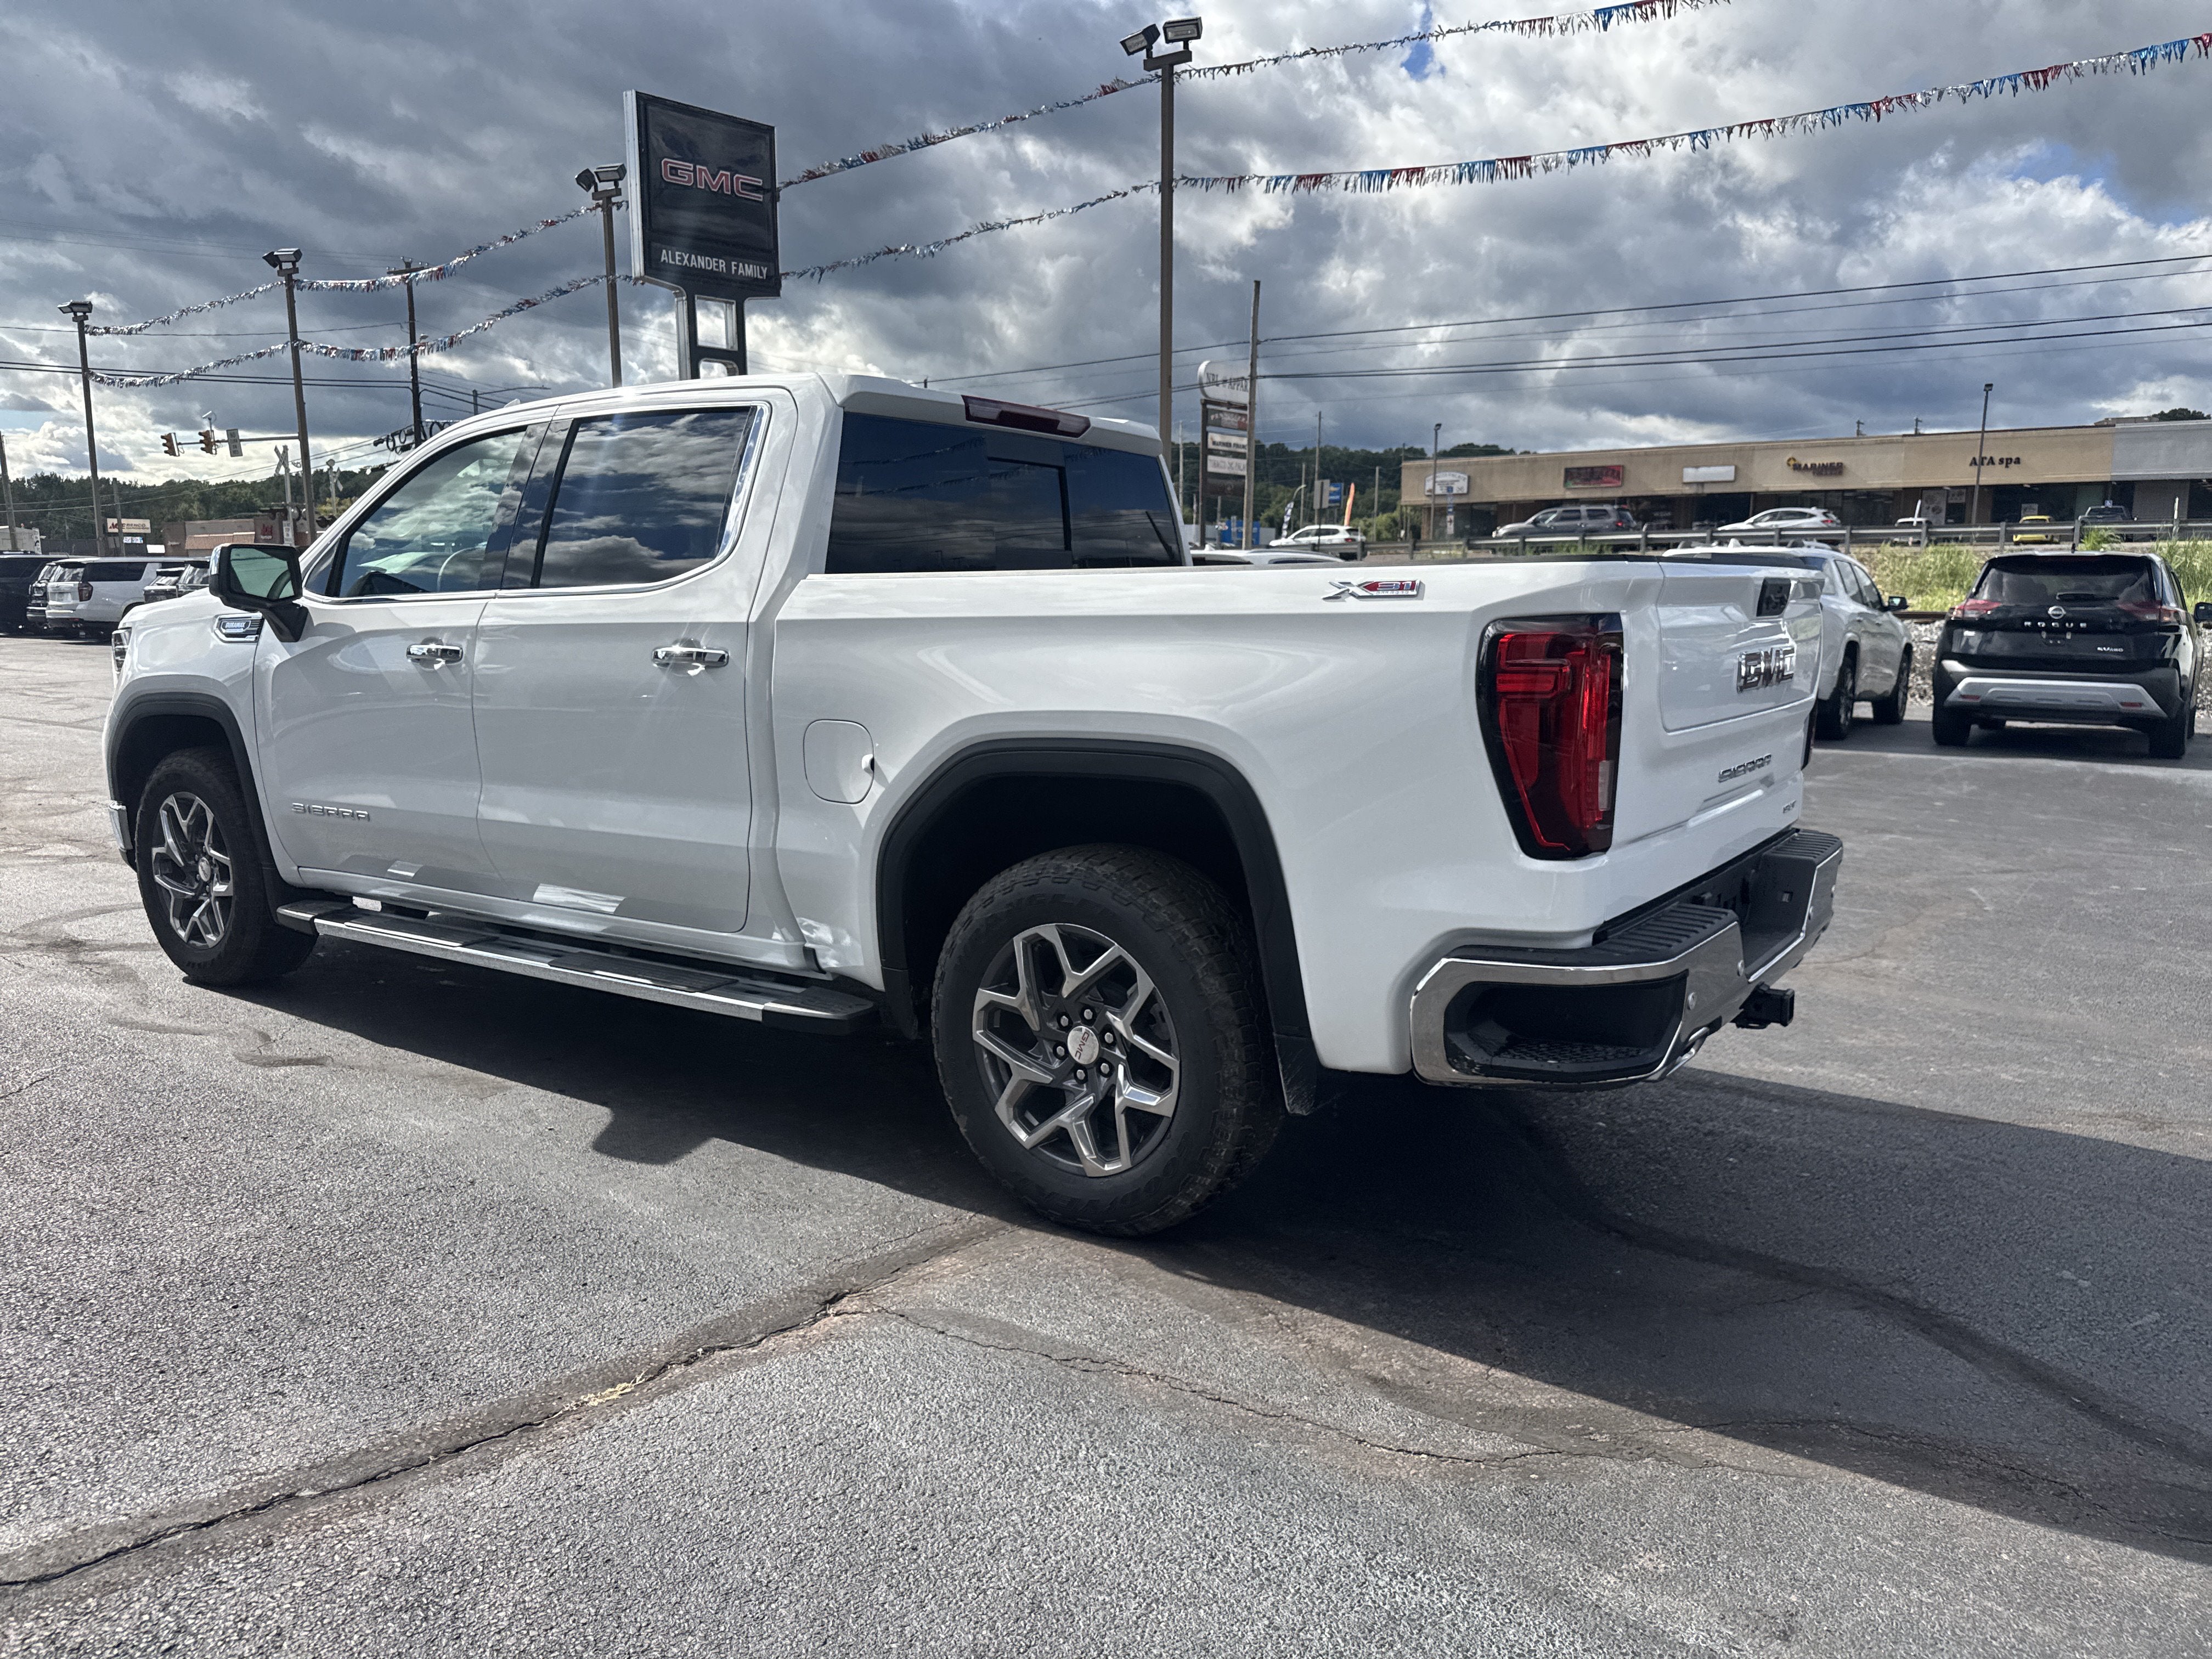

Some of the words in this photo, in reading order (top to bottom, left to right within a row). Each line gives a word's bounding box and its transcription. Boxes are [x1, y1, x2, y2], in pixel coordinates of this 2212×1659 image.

[661, 157, 763, 202] GMC
[660, 249, 726, 273] ALEXANDER
[731, 261, 768, 280] FAMILY
[1793, 462, 1843, 471] MARINER
[1998, 456, 2021, 468] spa
[1737, 647, 1797, 693] GMC
[1718, 753, 1772, 783] SIERRA
[291, 802, 371, 822] SIERRA
[1075, 1031, 1090, 1060] GMC
